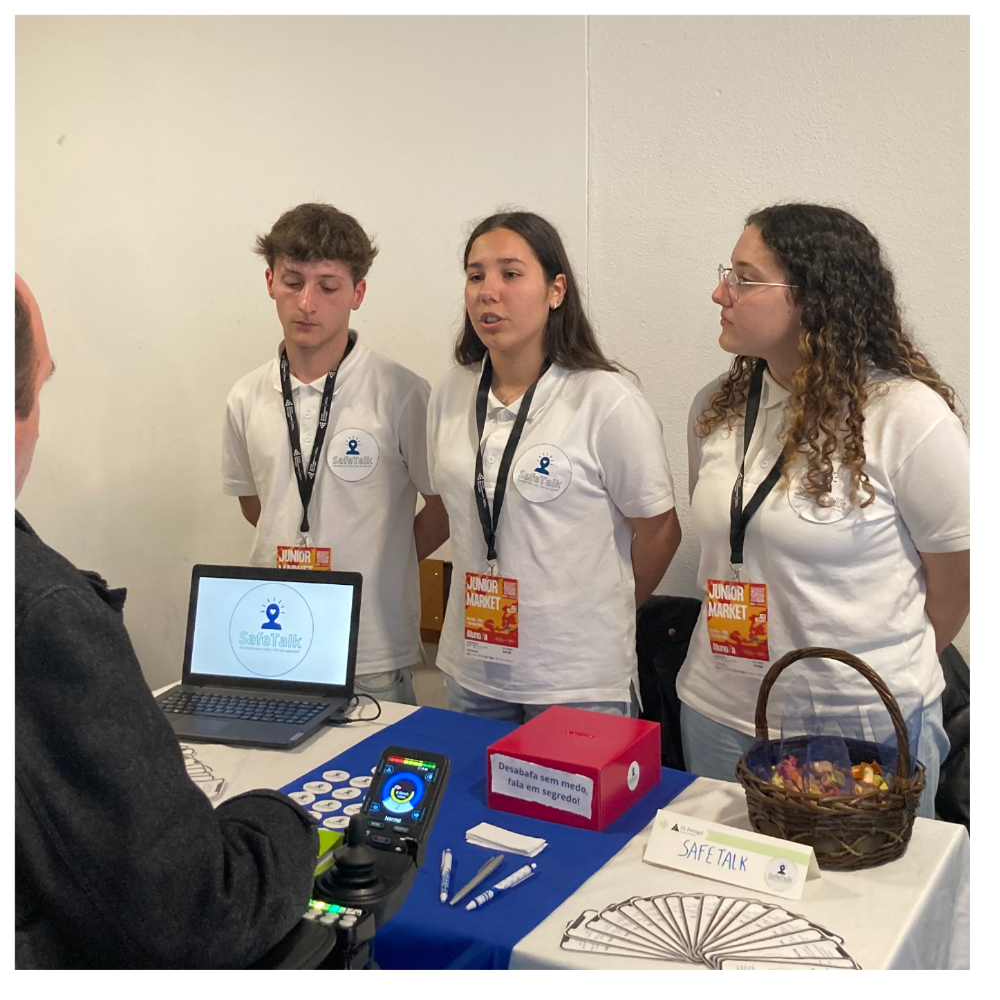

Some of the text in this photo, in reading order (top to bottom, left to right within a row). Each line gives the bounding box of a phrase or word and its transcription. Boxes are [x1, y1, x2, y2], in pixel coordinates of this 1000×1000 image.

[332, 455, 373, 465] SafeTalk
[517, 469, 562, 489] SafeTalk
[278, 549, 311, 563] JUNIOR
[466, 576, 499, 594] JUNIOR
[708, 583, 744, 602] JUNIOR
[466, 591, 501, 611] MARKET
[708, 601, 747, 620] MARKET
[239, 630, 303, 649] SafeTalk
[498, 761, 588, 795] Desabafa sem medo,
[507, 777, 580, 805] fala em segredo!
